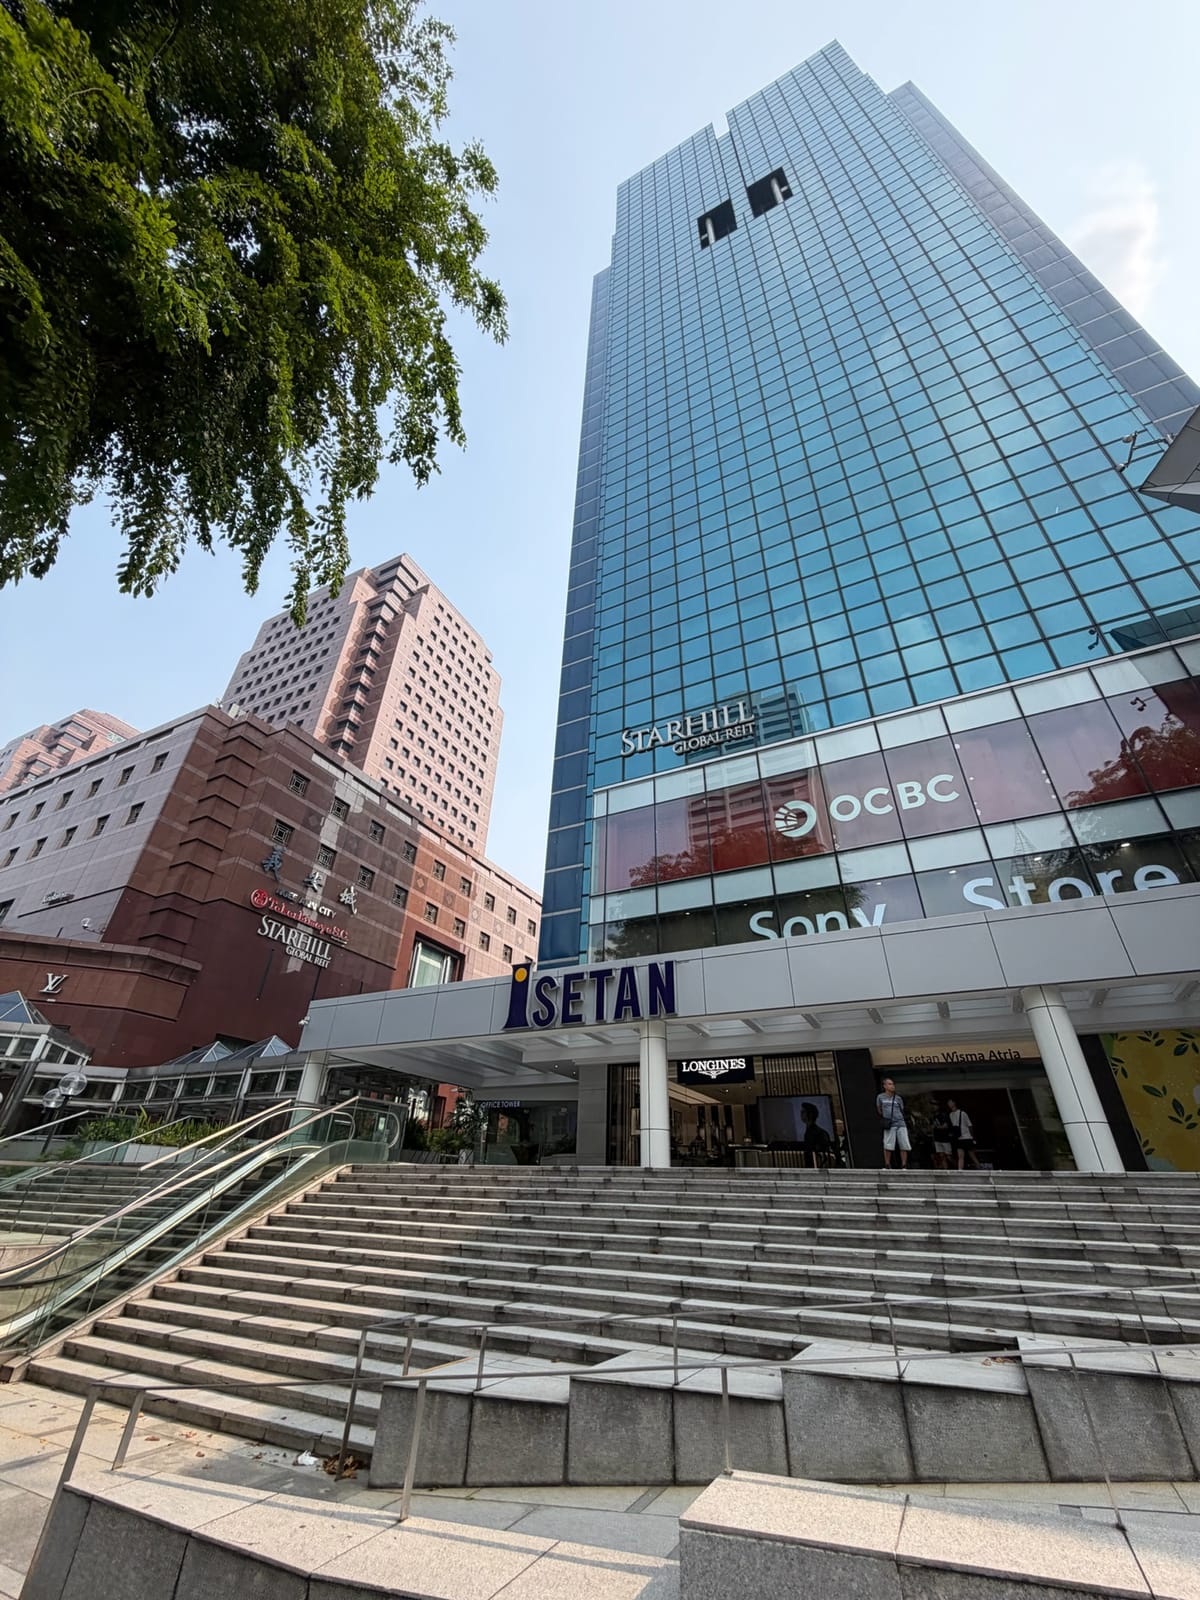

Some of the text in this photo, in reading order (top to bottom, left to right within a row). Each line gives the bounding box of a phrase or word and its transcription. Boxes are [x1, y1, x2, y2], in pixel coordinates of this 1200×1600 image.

[620, 701, 755, 756] STARHILL
[673, 722, 755, 754] GLOBAL REIT
[829, 774, 960, 822] OCBC
[319, 905, 337, 919] CITY
[257, 915, 332, 960] STARHILL
[286, 945, 331, 968] GLOBAL REIT
[682, 1058, 746, 1072] LONGINES
[905, 1048, 1021, 1064] Isetan Wisma Atria
[501, 1100, 521, 1108] TOWER
